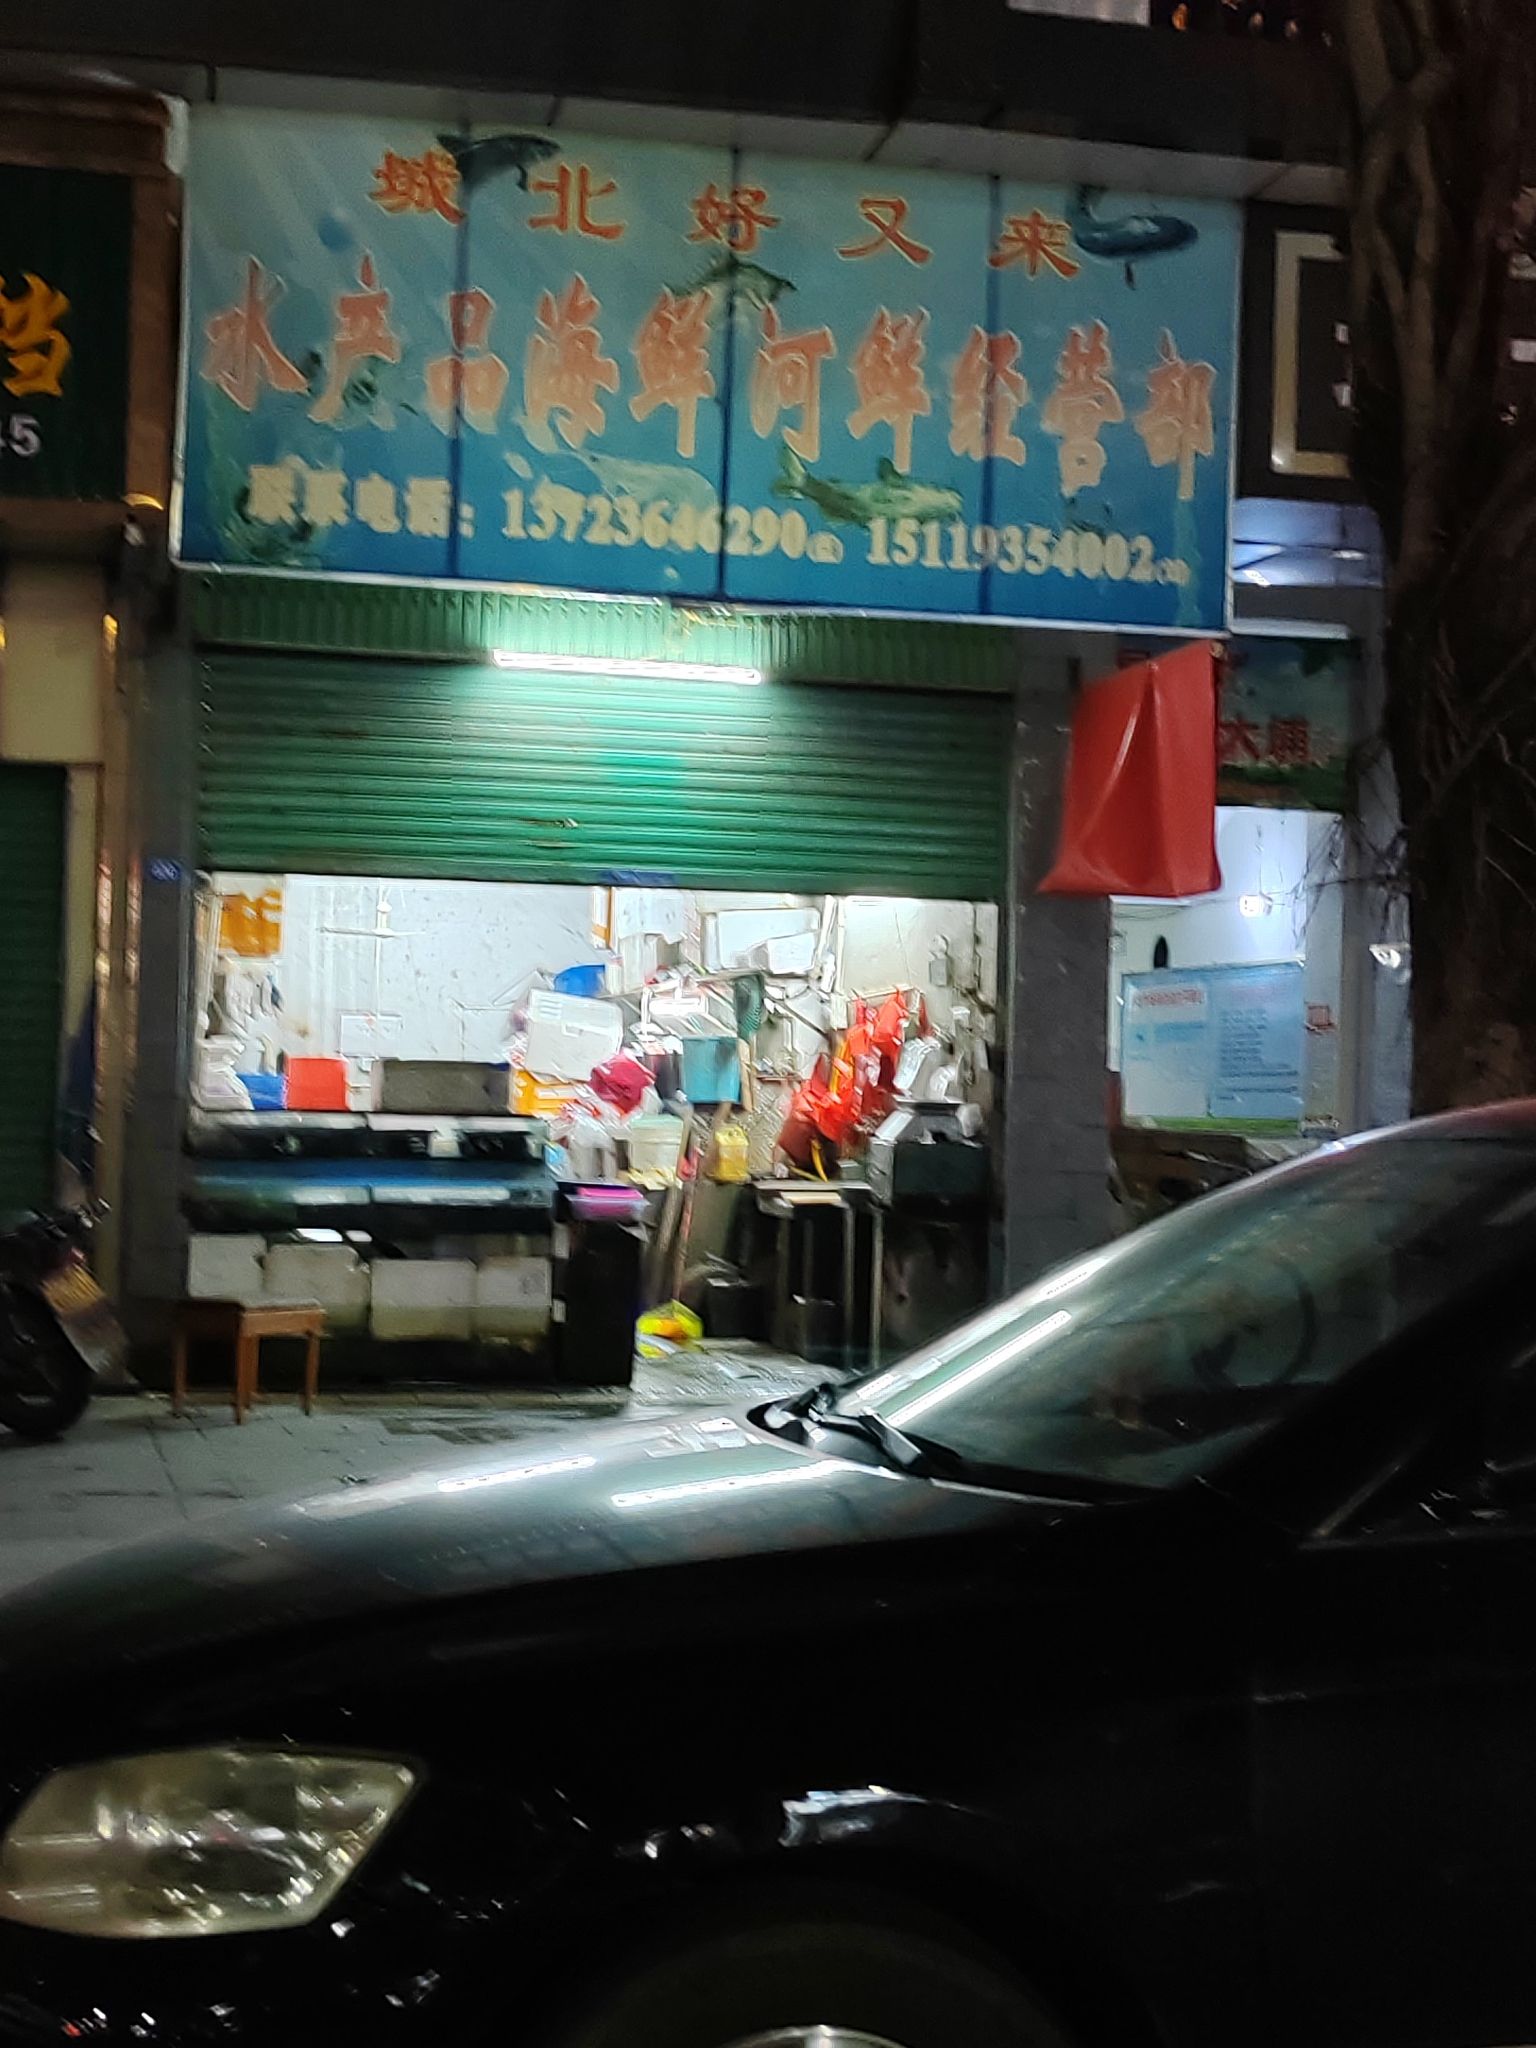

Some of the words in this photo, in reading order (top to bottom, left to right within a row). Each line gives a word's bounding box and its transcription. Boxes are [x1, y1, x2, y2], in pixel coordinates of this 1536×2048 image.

[368, 147, 1081, 280] 城北好又来
